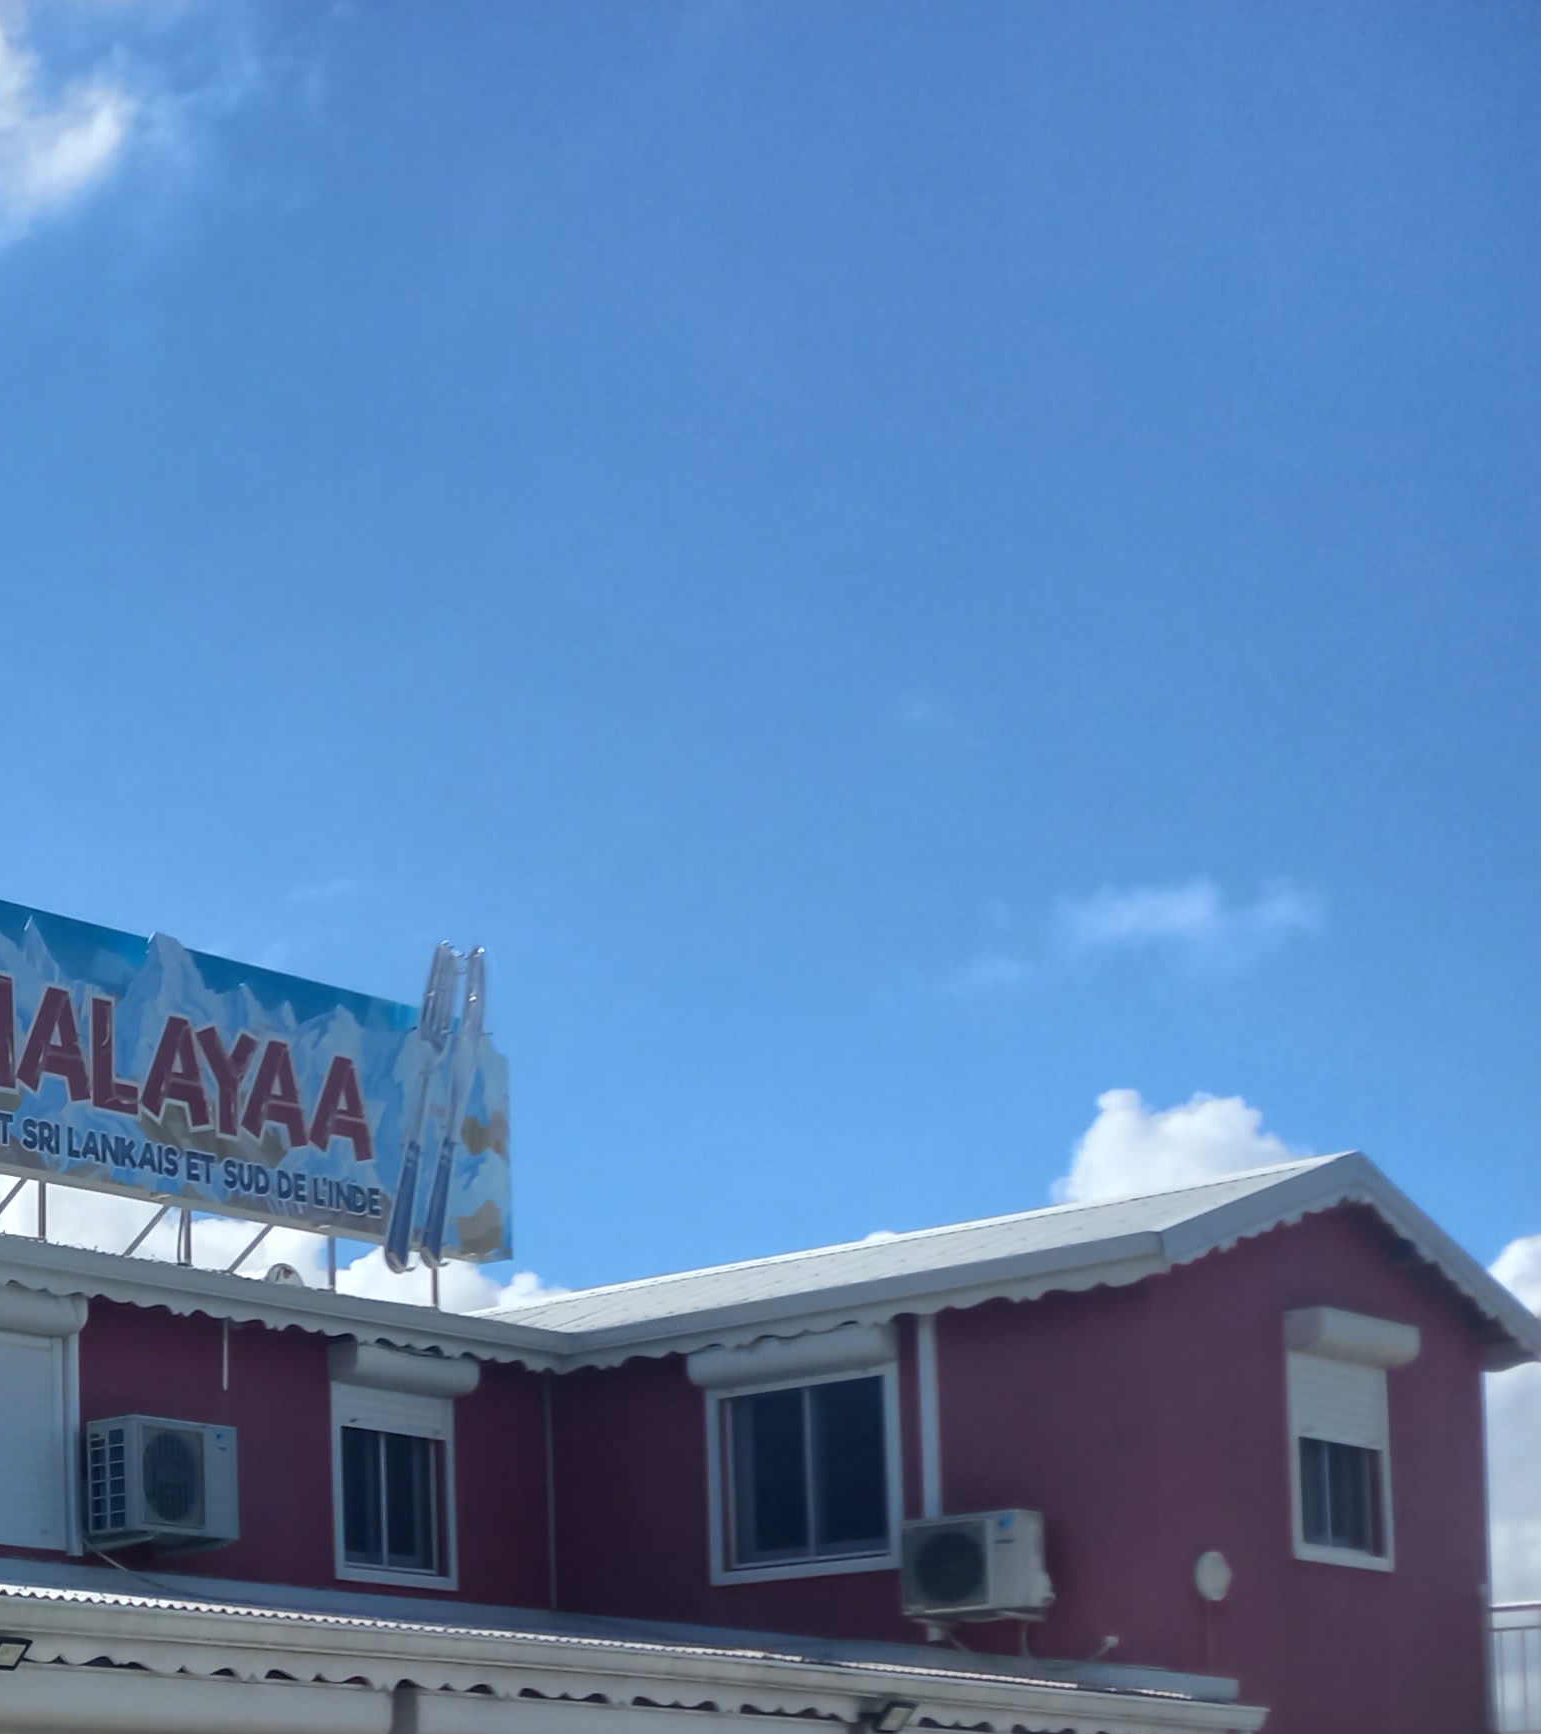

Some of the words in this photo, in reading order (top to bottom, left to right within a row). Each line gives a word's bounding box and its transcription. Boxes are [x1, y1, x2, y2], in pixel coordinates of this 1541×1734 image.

[22, 1117, 60, 1155] SRI
[66, 1126, 179, 1178] LANKAIS
[185, 1149, 215, 1184] ET
[223, 1158, 270, 1196] SUD
[277, 1169, 306, 1202] DE
[313, 1176, 382, 1219] L'INDE
